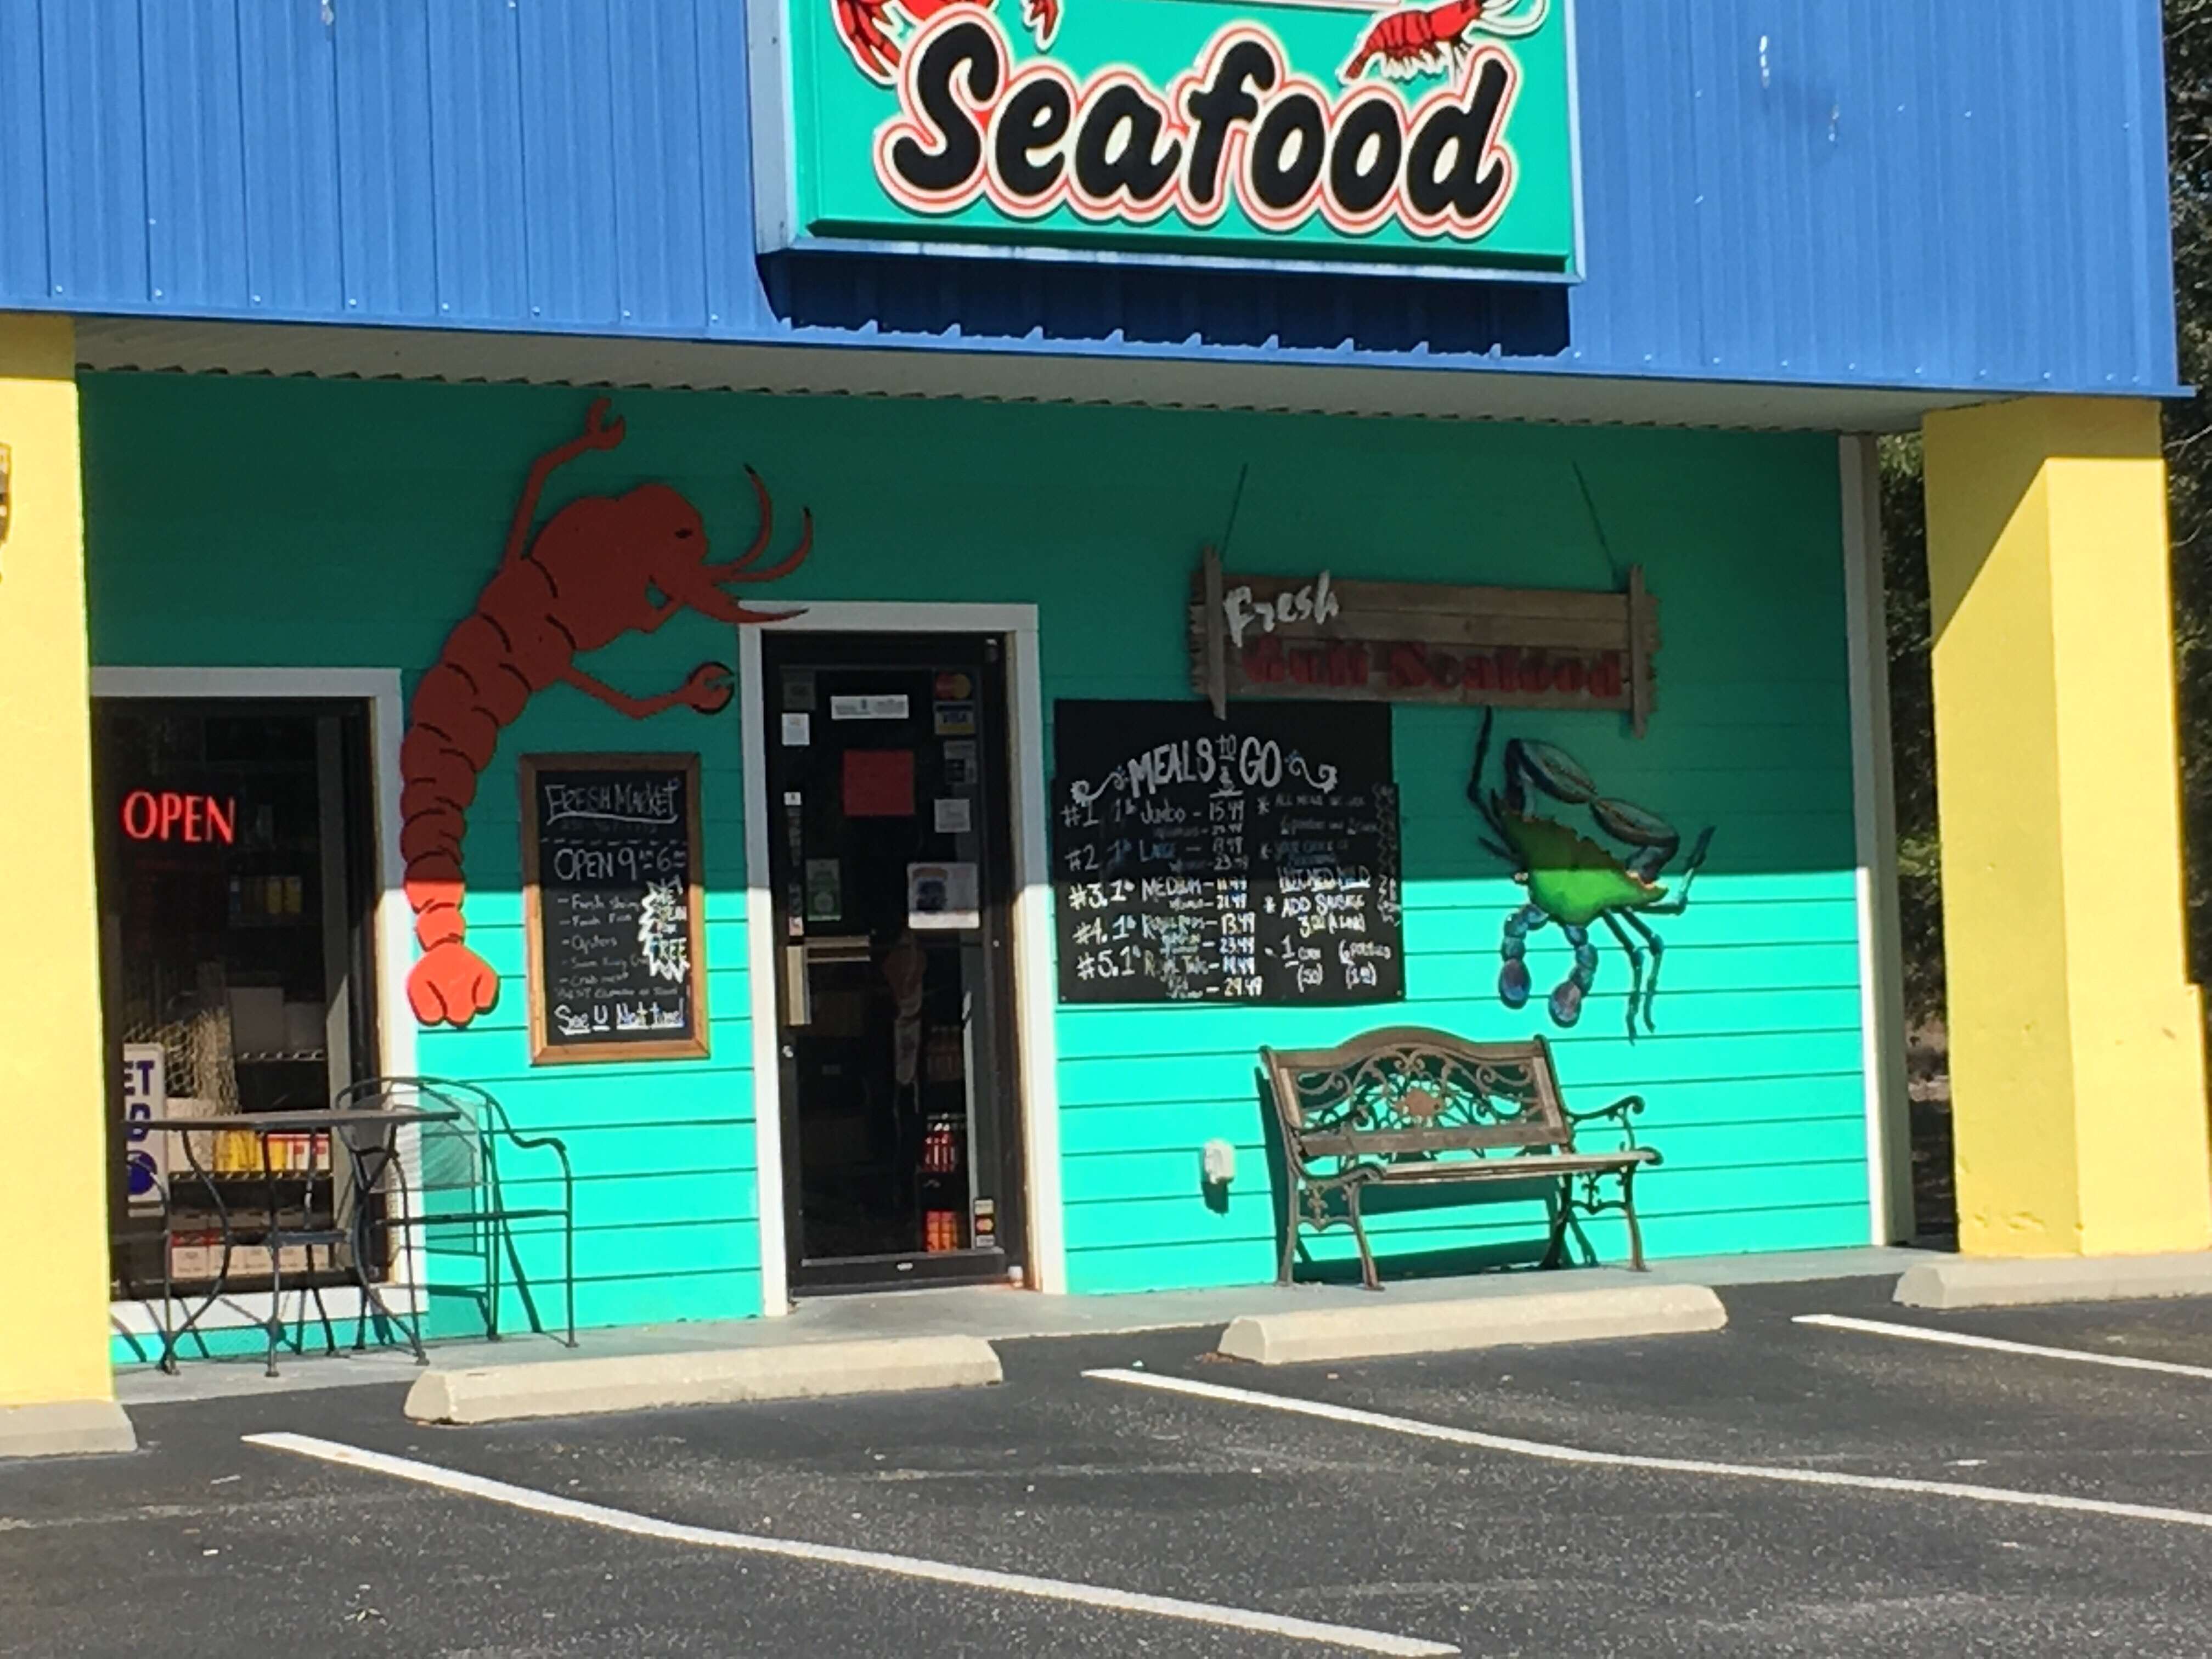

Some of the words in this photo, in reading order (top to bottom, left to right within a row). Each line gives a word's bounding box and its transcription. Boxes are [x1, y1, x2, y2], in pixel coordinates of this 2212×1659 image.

[890, 20, 1505, 219] Seafood
[1223, 569, 1340, 647] Fresh
[1127, 737, 1216, 798] MEALS
[1239, 736, 1283, 788] GO
[121, 790, 236, 844] OPEN
[544, 783, 611, 816] FRESH
[553, 848, 614, 881] OPEN
[617, 847, 638, 882] 9
[656, 846, 671, 872] 6
[553, 1003, 590, 1030] See
[593, 1004, 609, 1025] U
